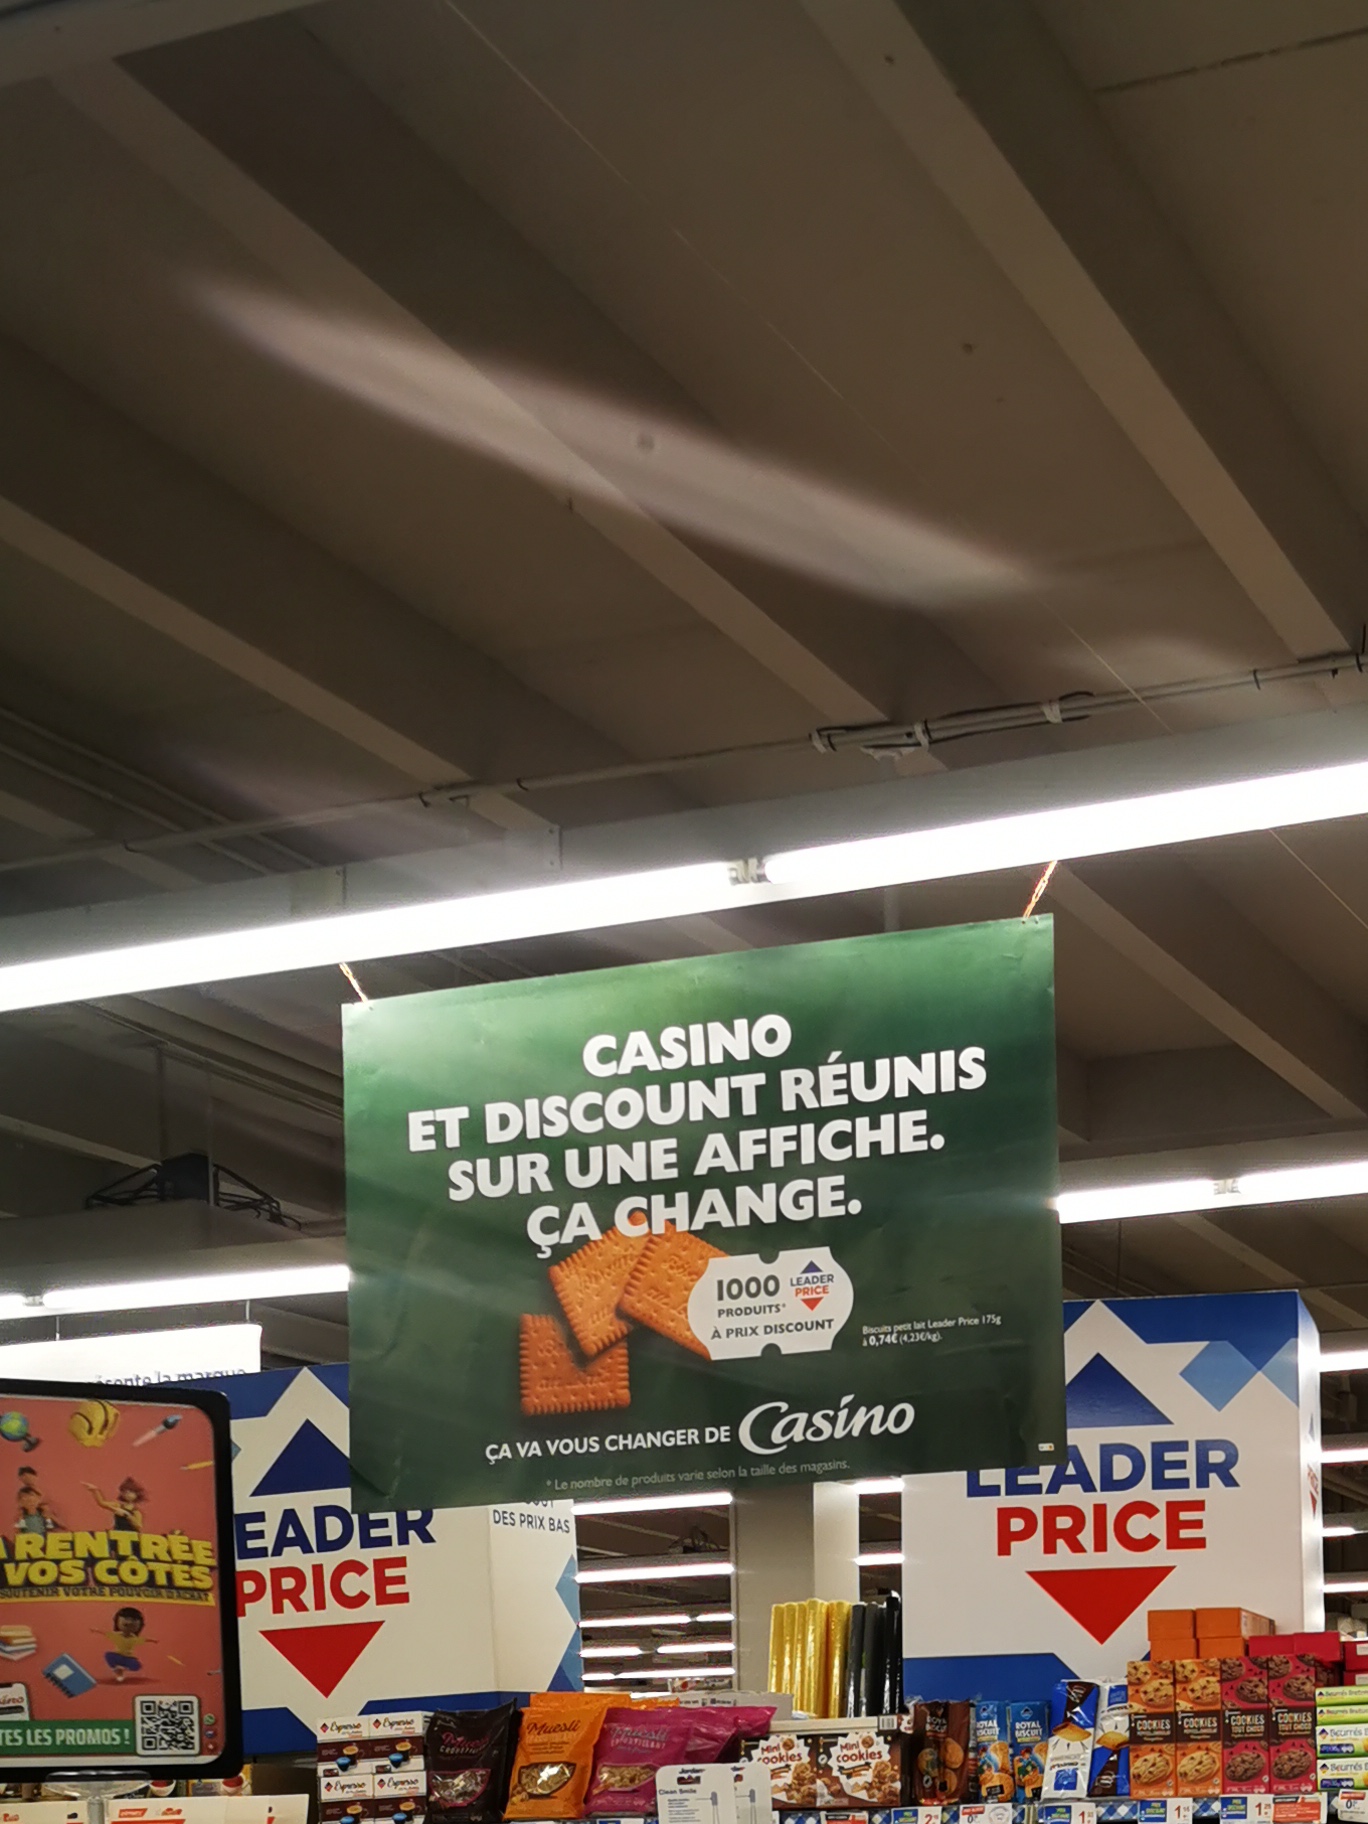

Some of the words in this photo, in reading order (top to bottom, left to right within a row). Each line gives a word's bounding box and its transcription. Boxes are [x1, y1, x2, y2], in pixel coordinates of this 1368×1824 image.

[582, 1014, 792, 1078] CASINO
[407, 1106, 470, 1153] ET
[485, 1072, 766, 1146] DISCOUNT
[781, 1046, 987, 1112] RÉUNIS
[447, 1153, 552, 1202] SUR
[564, 1137, 679, 1188] UNE
[694, 1110, 945, 1176] AFFICHE.
[526, 1202, 602, 1259] ÇA
[612, 1175, 863, 1241] CHANGE.
[716, 1274, 780, 1301] 1000
[789, 1273, 835, 1286] LEADER
[794, 1284, 830, 1298] PRICE
[711, 1324, 722, 1340] À
[725, 1325, 759, 1339] PRIX
[763, 1319, 834, 1336] DISCOUNT
[862, 1324, 892, 1335] Biscuits
[913, 1320, 926, 1330] lait
[927, 1317, 956, 1329] Leader
[957, 1316, 980, 1327] Price
[981, 1313, 1002, 1327] 175g
[869, 1333, 898, 1347] 0,74€
[738, 1394, 915, 1455] Casino
[485, 1443, 511, 1465] ÇA
[516, 1441, 542, 1459] VA
[546, 1436, 600, 1456] VOUS
[604, 1429, 700, 1451] CHANGER
[705, 1426, 731, 1443] DE
[554, 1479, 568, 1491] Le
[570, 1475, 612, 1489] nombre
[615, 1474, 629, 1487] de
[631, 1472, 676, 1490] produits
[677, 1470, 704, 1482] varie
[706, 1467, 735, 1480] selon
[738, 1466, 748, 1478] la
[750, 1463, 776, 1477] taille
[778, 1462, 797, 1474] des
[800, 1459, 850, 1476] magasins.
[966, 1438, 1240, 1499] LEADER
[493, 1509, 516, 1526] DES
[520, 1513, 545, 1530] PRIX
[549, 1517, 570, 1534] BAS
[996, 1500, 1207, 1556] PRICE
[15, 1530, 217, 1566] RENTRÉE
[4, 1560, 85, 1586] VOS
[95, 1554, 214, 1590] CÔTÉS
[64, 1586, 105, 1598] VOTRE
[236, 1555, 411, 1618] PRICE
[1015, 1720, 1041, 1730] ROYAL
[1136, 1718, 1171, 1730] COOKIES
[1183, 1716, 1218, 1728] COOKIES
[1230, 1714, 1265, 1726] COOKIES
[1277, 1711, 1312, 1723] COOKIES
[26, 1729, 51, 1745] LES
[55, 1728, 121, 1745] PROMOS
[1014, 1728, 1043, 1738] BISCUIT
[1330, 1728, 1362, 1737] Beurrés
[760, 1744, 781, 1755] Mini
[839, 1741, 860, 1752] Mini
[836, 1750, 883, 1763] cookies
[1330, 1762, 1362, 1771] Beurrés
